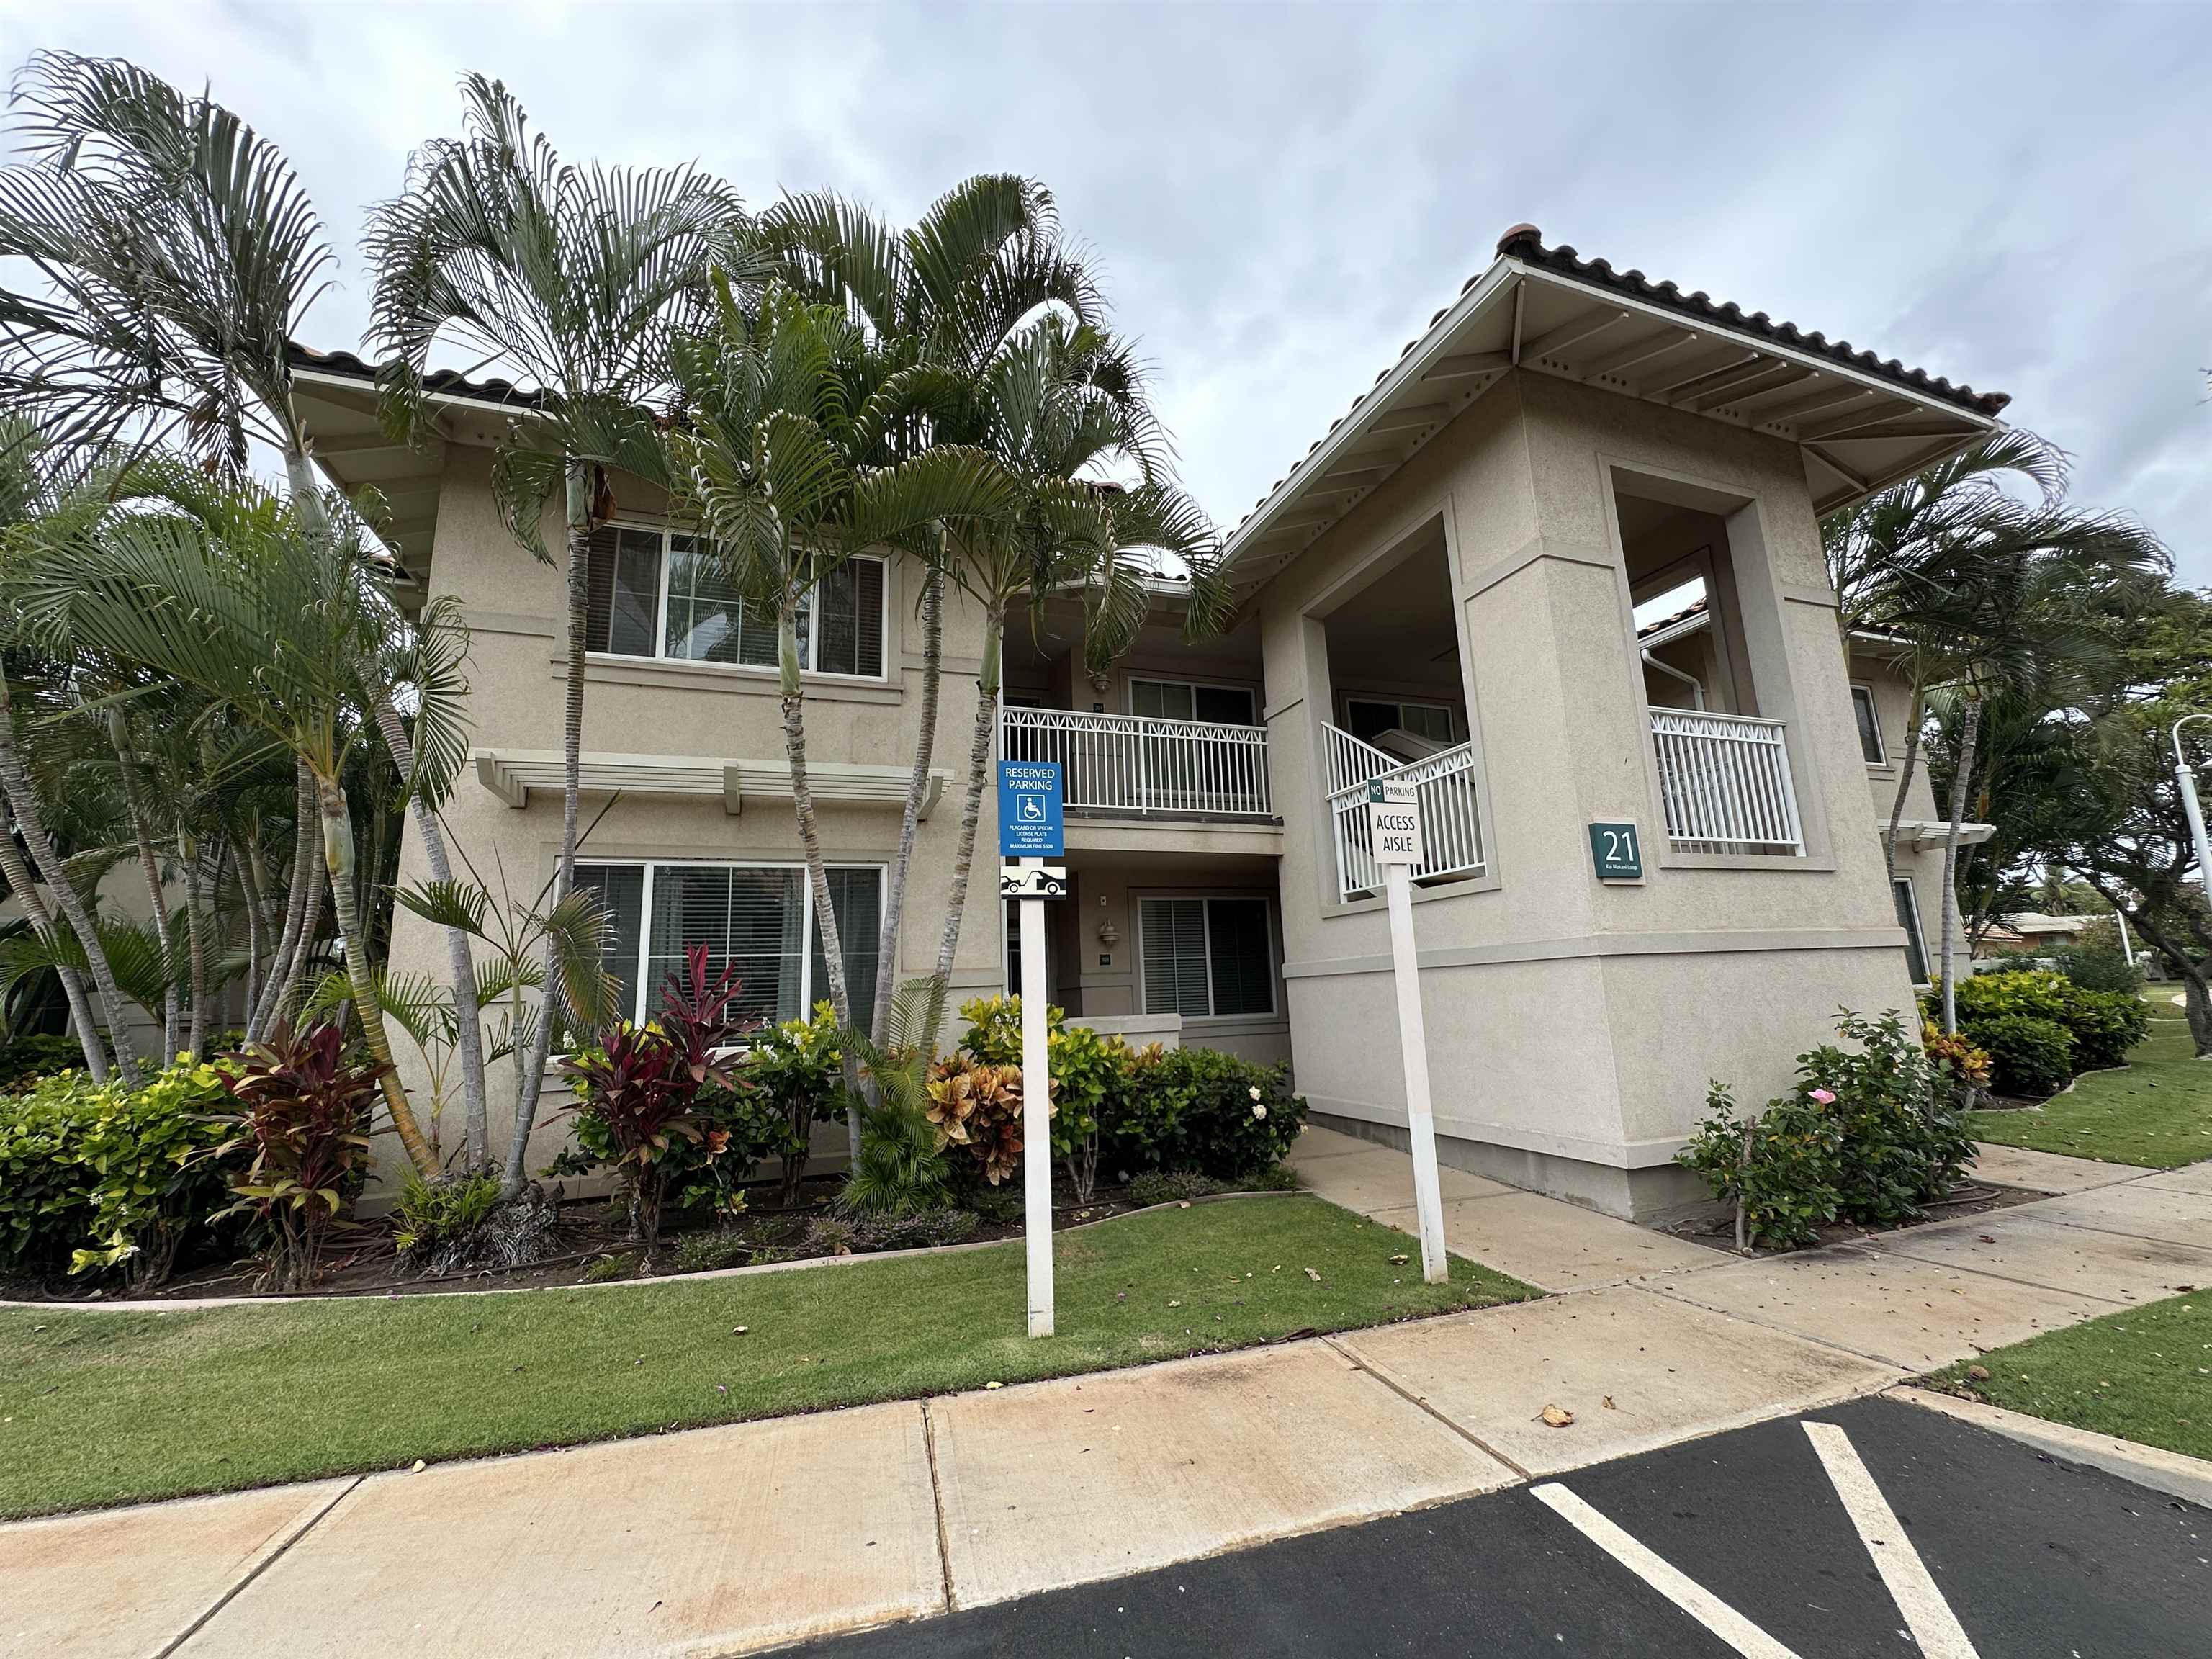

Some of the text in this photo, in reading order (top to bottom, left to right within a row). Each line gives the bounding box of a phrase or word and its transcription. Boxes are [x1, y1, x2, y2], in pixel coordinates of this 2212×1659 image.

[1005, 768, 1055, 778] RESERVED
[1009, 780, 1053, 791] PARKING
[1370, 786, 1414, 796] NO PARKING
[1377, 814, 1415, 830] ACCESS
[1383, 836, 1413, 852] AISLE
[1603, 830, 1634, 861] 21
